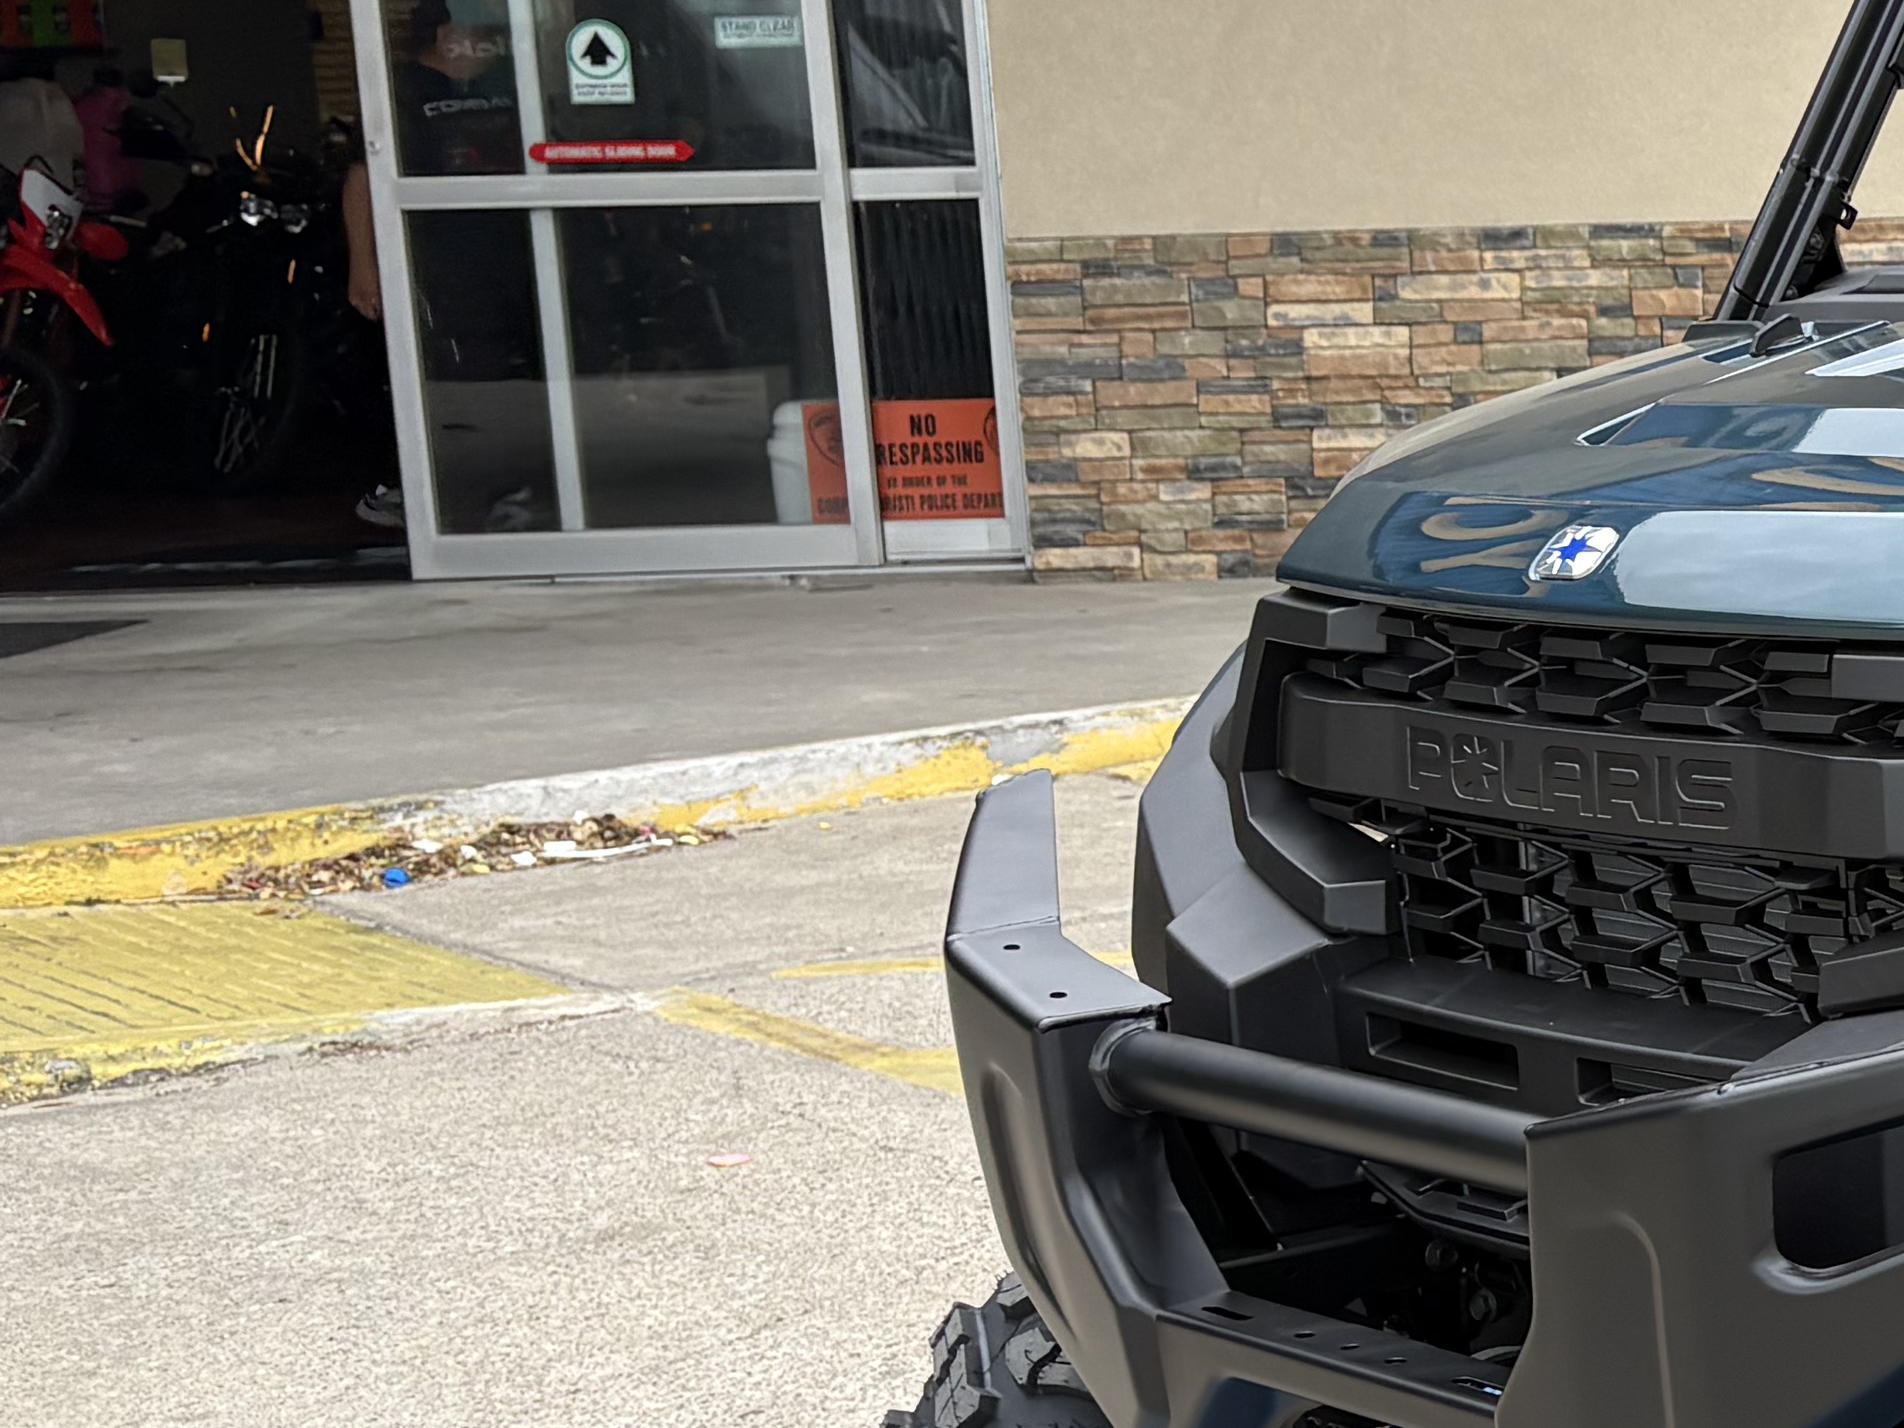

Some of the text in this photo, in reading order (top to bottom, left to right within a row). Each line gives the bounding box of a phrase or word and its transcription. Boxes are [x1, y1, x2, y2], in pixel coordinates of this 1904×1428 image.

[909, 413, 937, 438] NO
[875, 440, 985, 466] RESPASSING
[920, 493, 957, 512] POLICE
[1404, 725, 1740, 831] POLARIS
